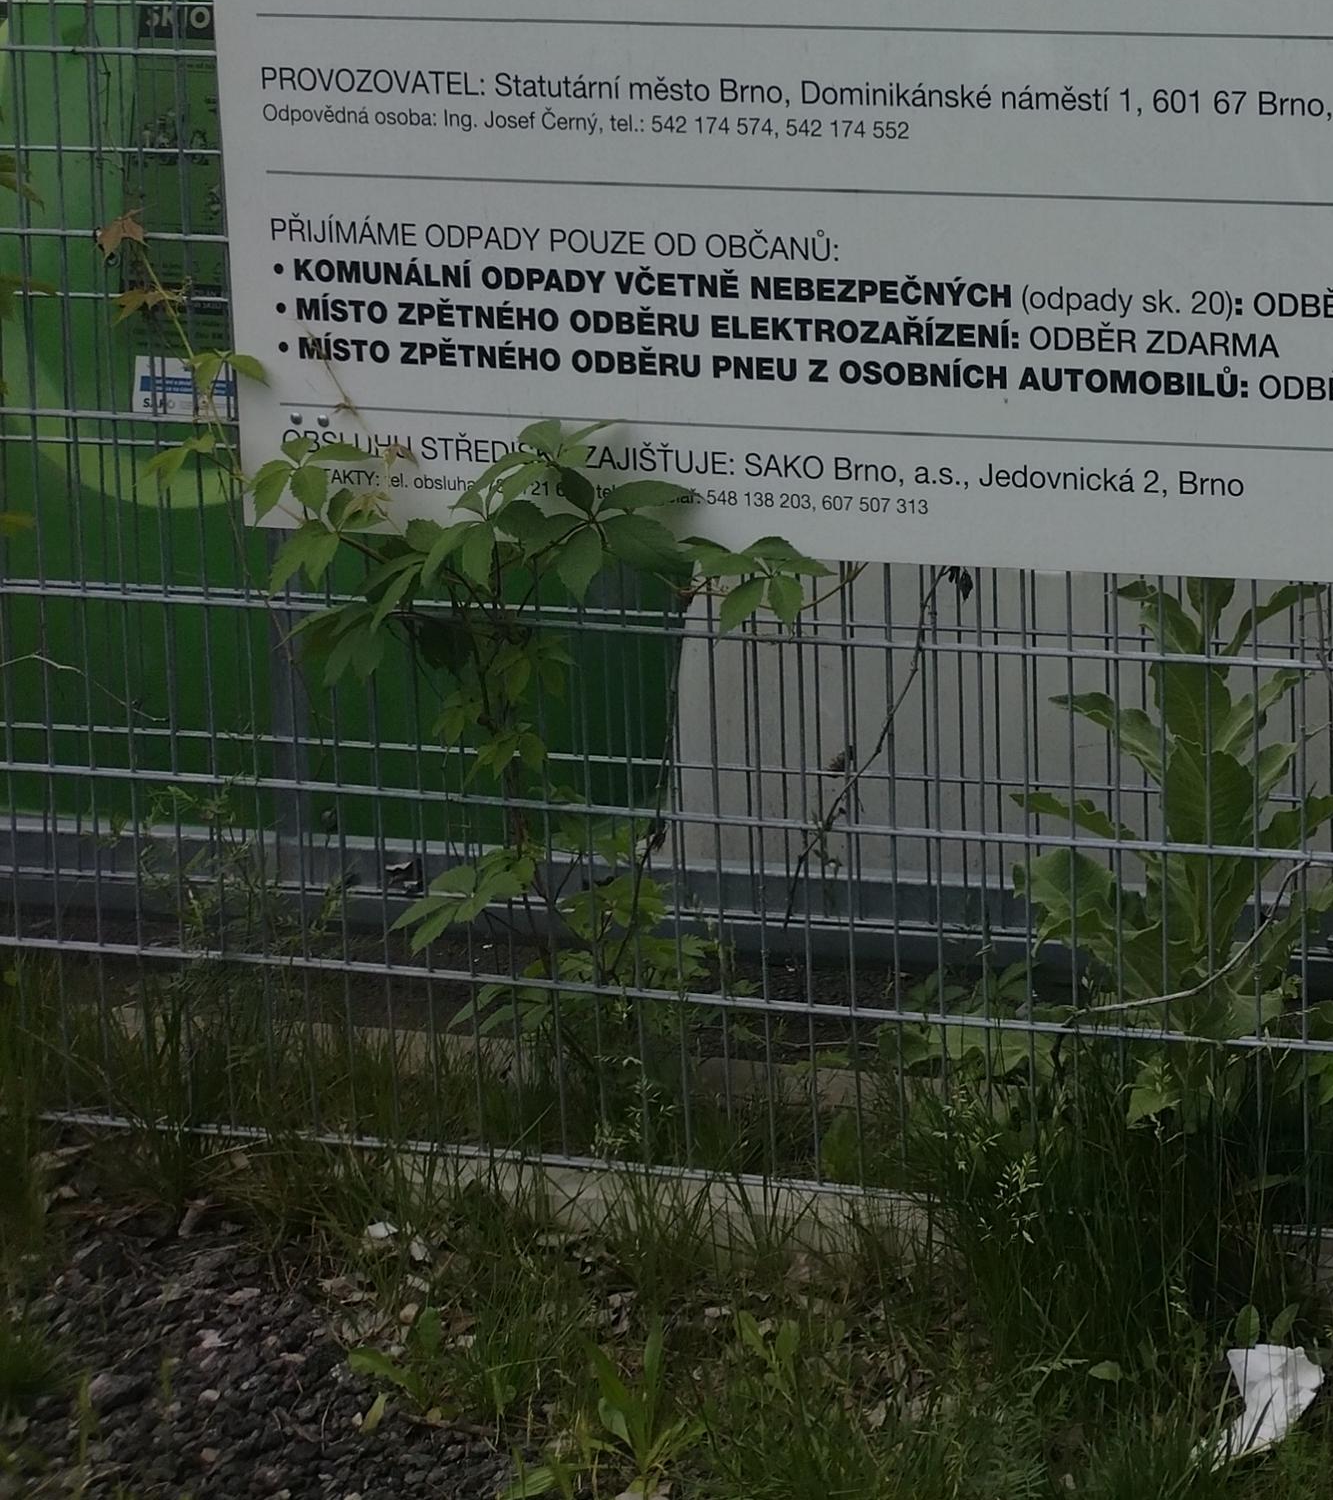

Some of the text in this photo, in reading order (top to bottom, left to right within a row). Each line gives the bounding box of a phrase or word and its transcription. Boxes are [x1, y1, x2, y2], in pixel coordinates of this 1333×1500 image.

[145, 5, 211, 29] SKO
[261, 66, 485, 96] PROVOZOVATEL:
[495, 72, 621, 100] Statutární
[629, 75, 710, 102] město
[719, 78, 790, 108] Brno,
[801, 80, 992, 109] Dominikánské
[1001, 84, 1110, 112] náměstí
[1119, 87, 1142, 117] 1,
[1152, 88, 1199, 114] 601
[1213, 90, 1247, 115] 67
[1258, 90, 1332, 122] Brno,
[262, 103, 910, 140] Odpovědná osoba: Ing. Josef Černý, tel.: 542 174 574, 542 174 552
[270, 212, 839, 262] PŘIJÍMÁME ODPADY POUZE OD OBČANŮ:
[293, 256, 472, 289] KOMUNÁLNÍ
[481, 265, 606, 294] ODPADY
[614, 265, 740, 299] VČETNĚ
[750, 274, 1012, 309] NEBEZPEČNÝCH
[1021, 284, 1133, 319] (odpady
[1142, 288, 1181, 314] sk.
[1191, 290, 1243, 322] 20):
[295, 292, 1280, 359] MÍSTO ZPĚTNÉHO ODBĚRU ELEKTROZAŘÍZENÍ: ODBĚR ZDARMA
[298, 331, 390, 364] MÍSTO
[399, 336, 561, 372] ZPĚTNÉHO
[571, 345, 701, 378] ODBĚRU
[712, 355, 797, 382] PNEU
[808, 358, 829, 383] Z
[839, 357, 1008, 390] OSOBNÍCH
[1018, 365, 1249, 399] AUTOMOBILŮ:
[585, 441, 735, 476] ZAJIŠŤUJE:
[744, 452, 824, 480] SAKO
[834, 456, 904, 487] Brno,
[914, 466, 969, 490] a.s.,
[978, 462, 1135, 493] Jedovnická
[1143, 469, 1168, 498] 2,
[1179, 470, 1244, 497] Brno
[706, 489, 738, 507] 548
[743, 491, 775, 508] 138
[779, 492, 817, 513] 203,
[821, 494, 854, 511] 607
[859, 496, 891, 513] 507
[896, 498, 929, 515] 313
